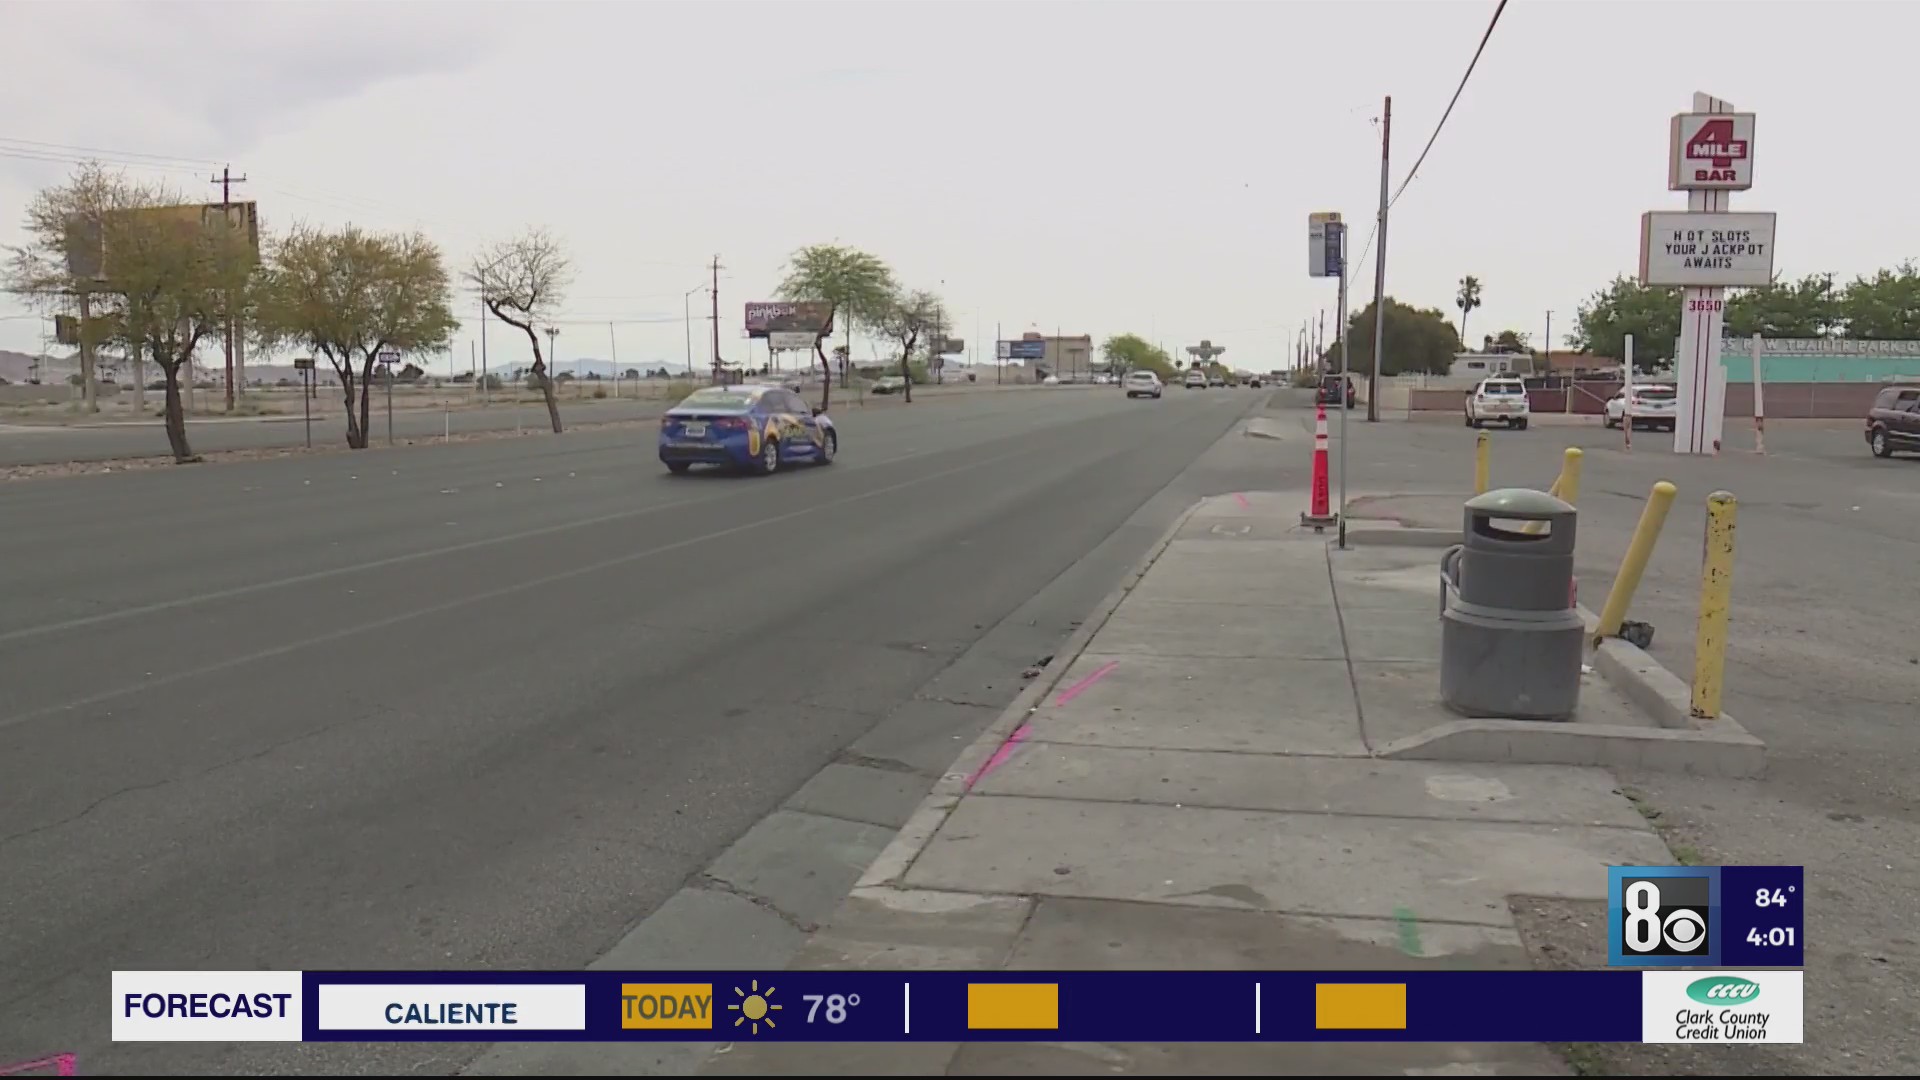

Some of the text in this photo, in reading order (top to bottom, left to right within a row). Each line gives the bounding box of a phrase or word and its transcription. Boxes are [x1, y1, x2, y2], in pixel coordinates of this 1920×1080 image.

[1686, 119, 1748, 168] 4
[1693, 143, 1743, 157] MILE
[1695, 169, 1737, 182] BAR
[1674, 230, 1750, 242] HOT SLOTS
[1665, 244, 1765, 255] YOUR JACKPOT
[1684, 256, 1732, 269] AWAITS
[748, 304, 797, 321] pinkbox
[1688, 299, 1723, 313] 3650
